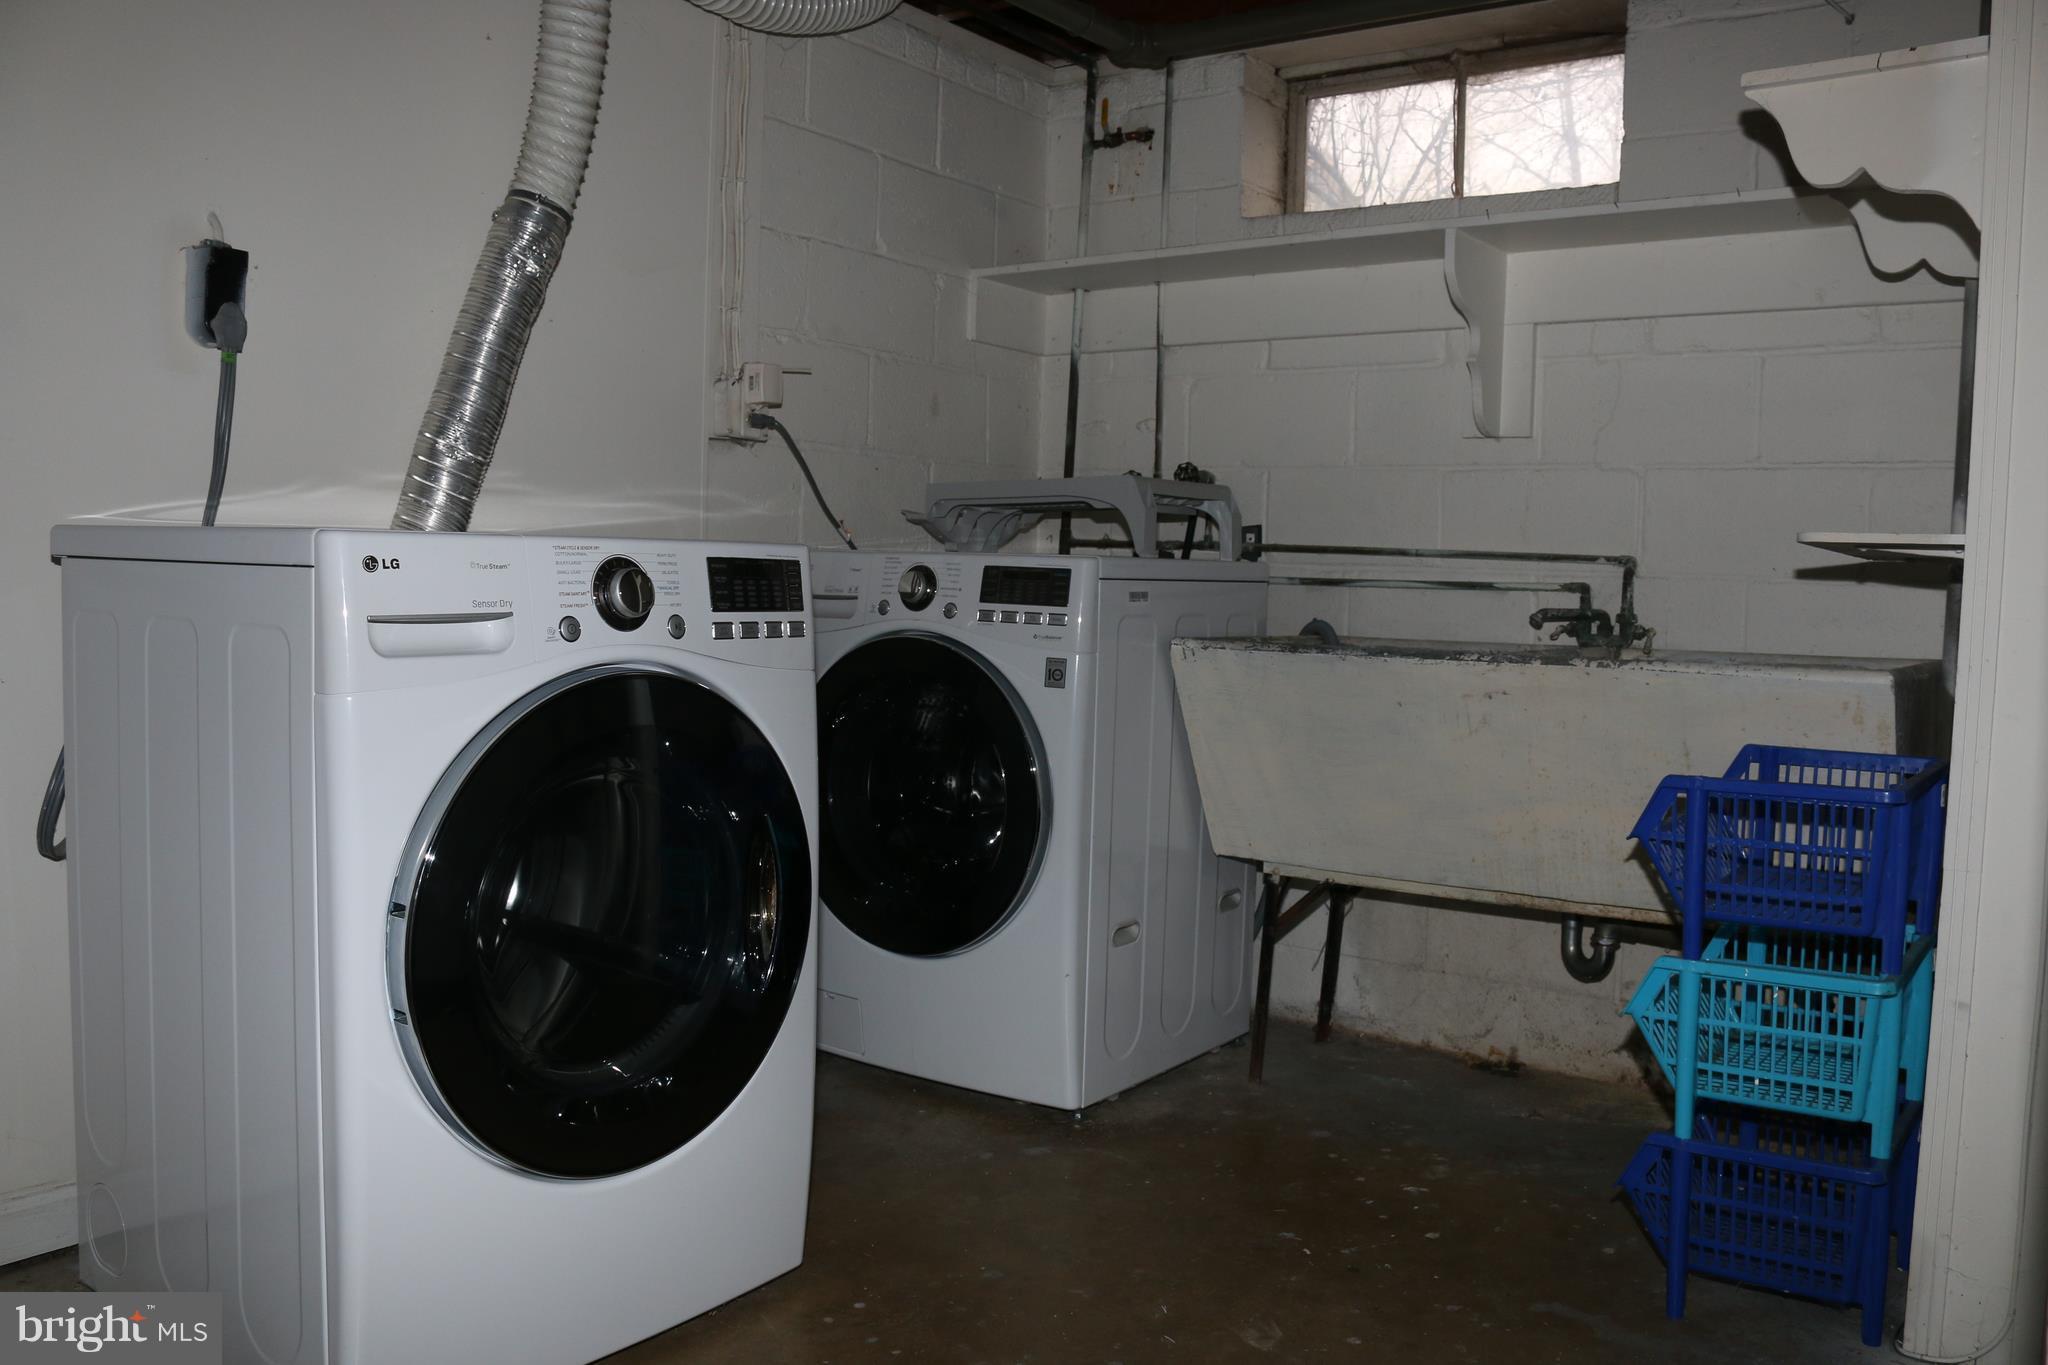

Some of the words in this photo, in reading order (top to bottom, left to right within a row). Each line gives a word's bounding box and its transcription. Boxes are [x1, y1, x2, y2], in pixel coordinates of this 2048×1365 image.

[382, 558, 400, 570] LG
[471, 599, 498, 609] Sensor
[499, 599, 513, 609] Dry
[1048, 668, 1064, 682] 10
